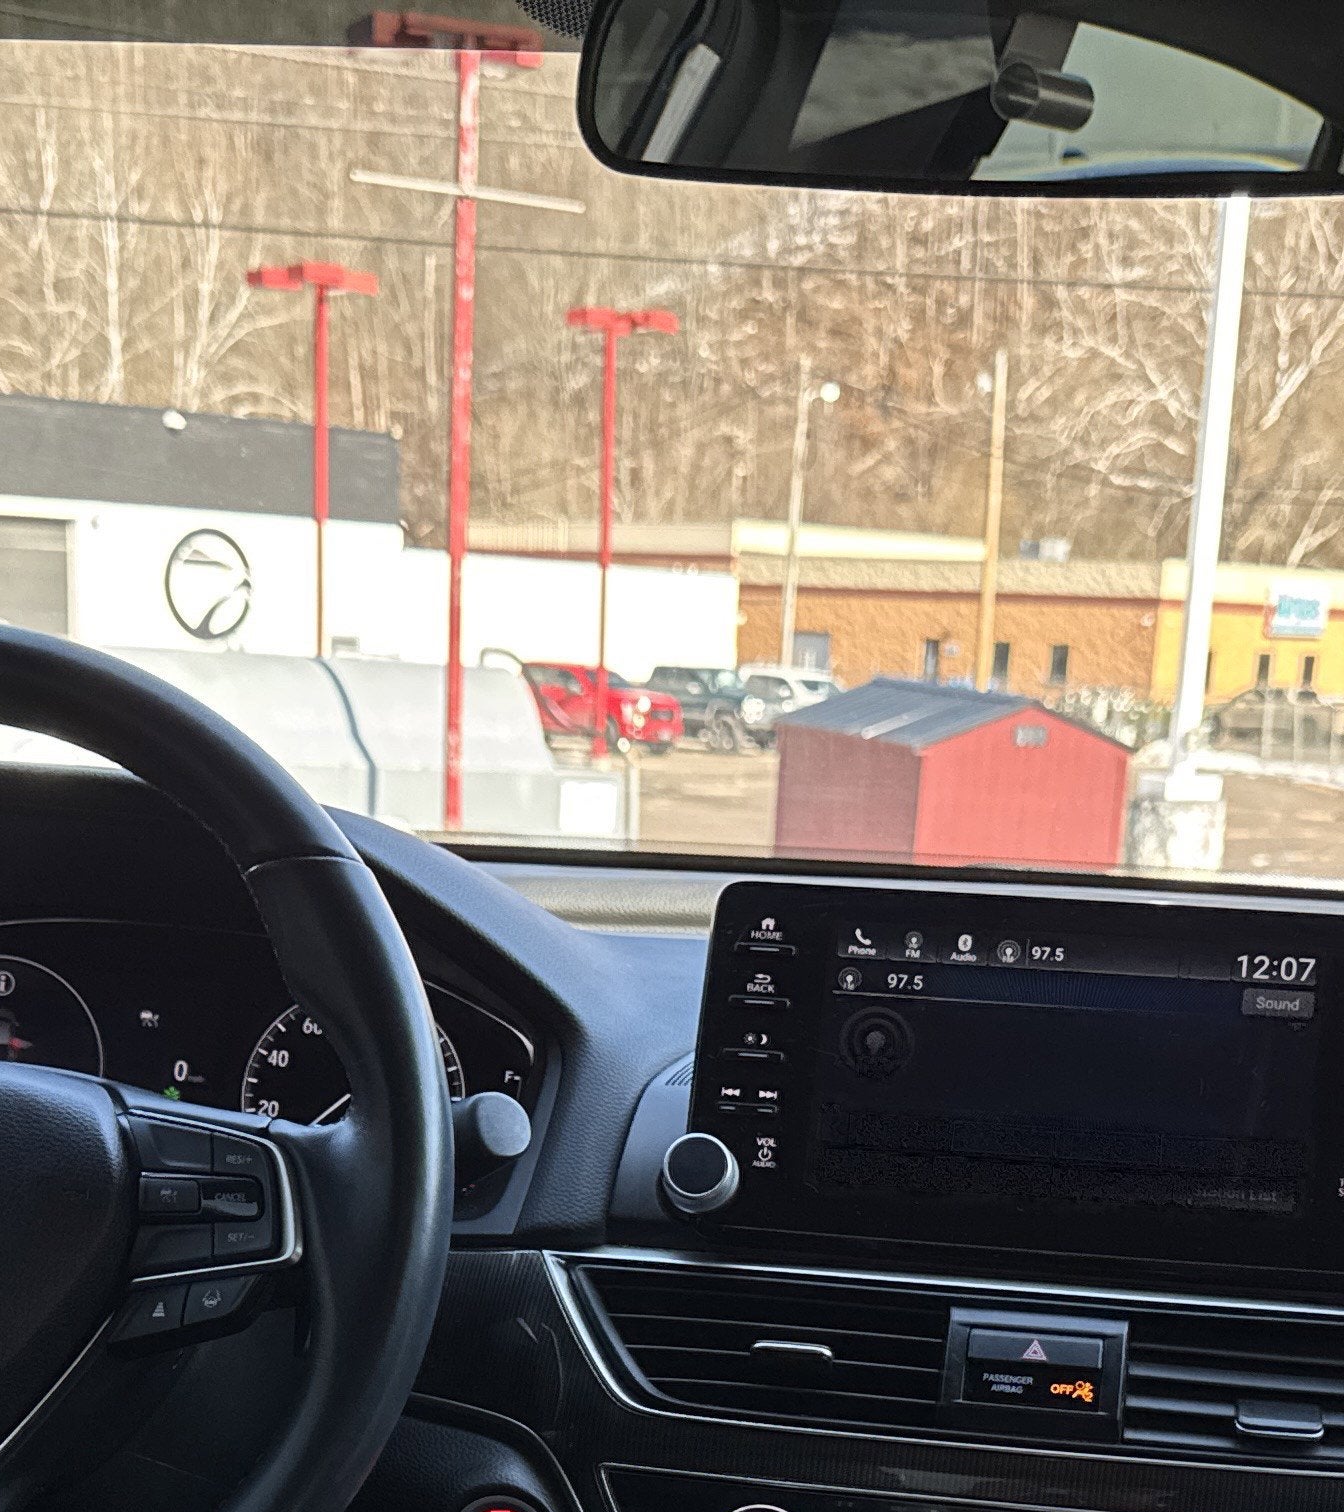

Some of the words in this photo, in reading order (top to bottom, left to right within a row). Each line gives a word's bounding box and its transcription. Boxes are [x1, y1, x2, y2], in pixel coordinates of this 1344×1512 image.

[751, 930, 783, 941] HOME
[848, 945, 877, 956] Phone
[905, 949, 921, 959] FM
[950, 952, 977, 963] Audio
[1031, 946, 1065, 962] 97.5
[1236, 954, 1317, 982] 12:07
[746, 983, 775, 994] BACK
[887, 974, 924, 990] 97.5
[1256, 996, 1300, 1012] Sound
[267, 1049, 290, 1068] 40
[173, 1059, 189, 1082] 0
[504, 1070, 515, 1084] F
[257, 1099, 279, 1118] 20
[756, 1137, 777, 1148] VOL
[752, 1160, 777, 1169] AUDIO
[982, 1372, 1034, 1386] PASSENGER
[991, 1383, 1024, 1395] AIRBAG
[1050, 1383, 1074, 1395] OFF
